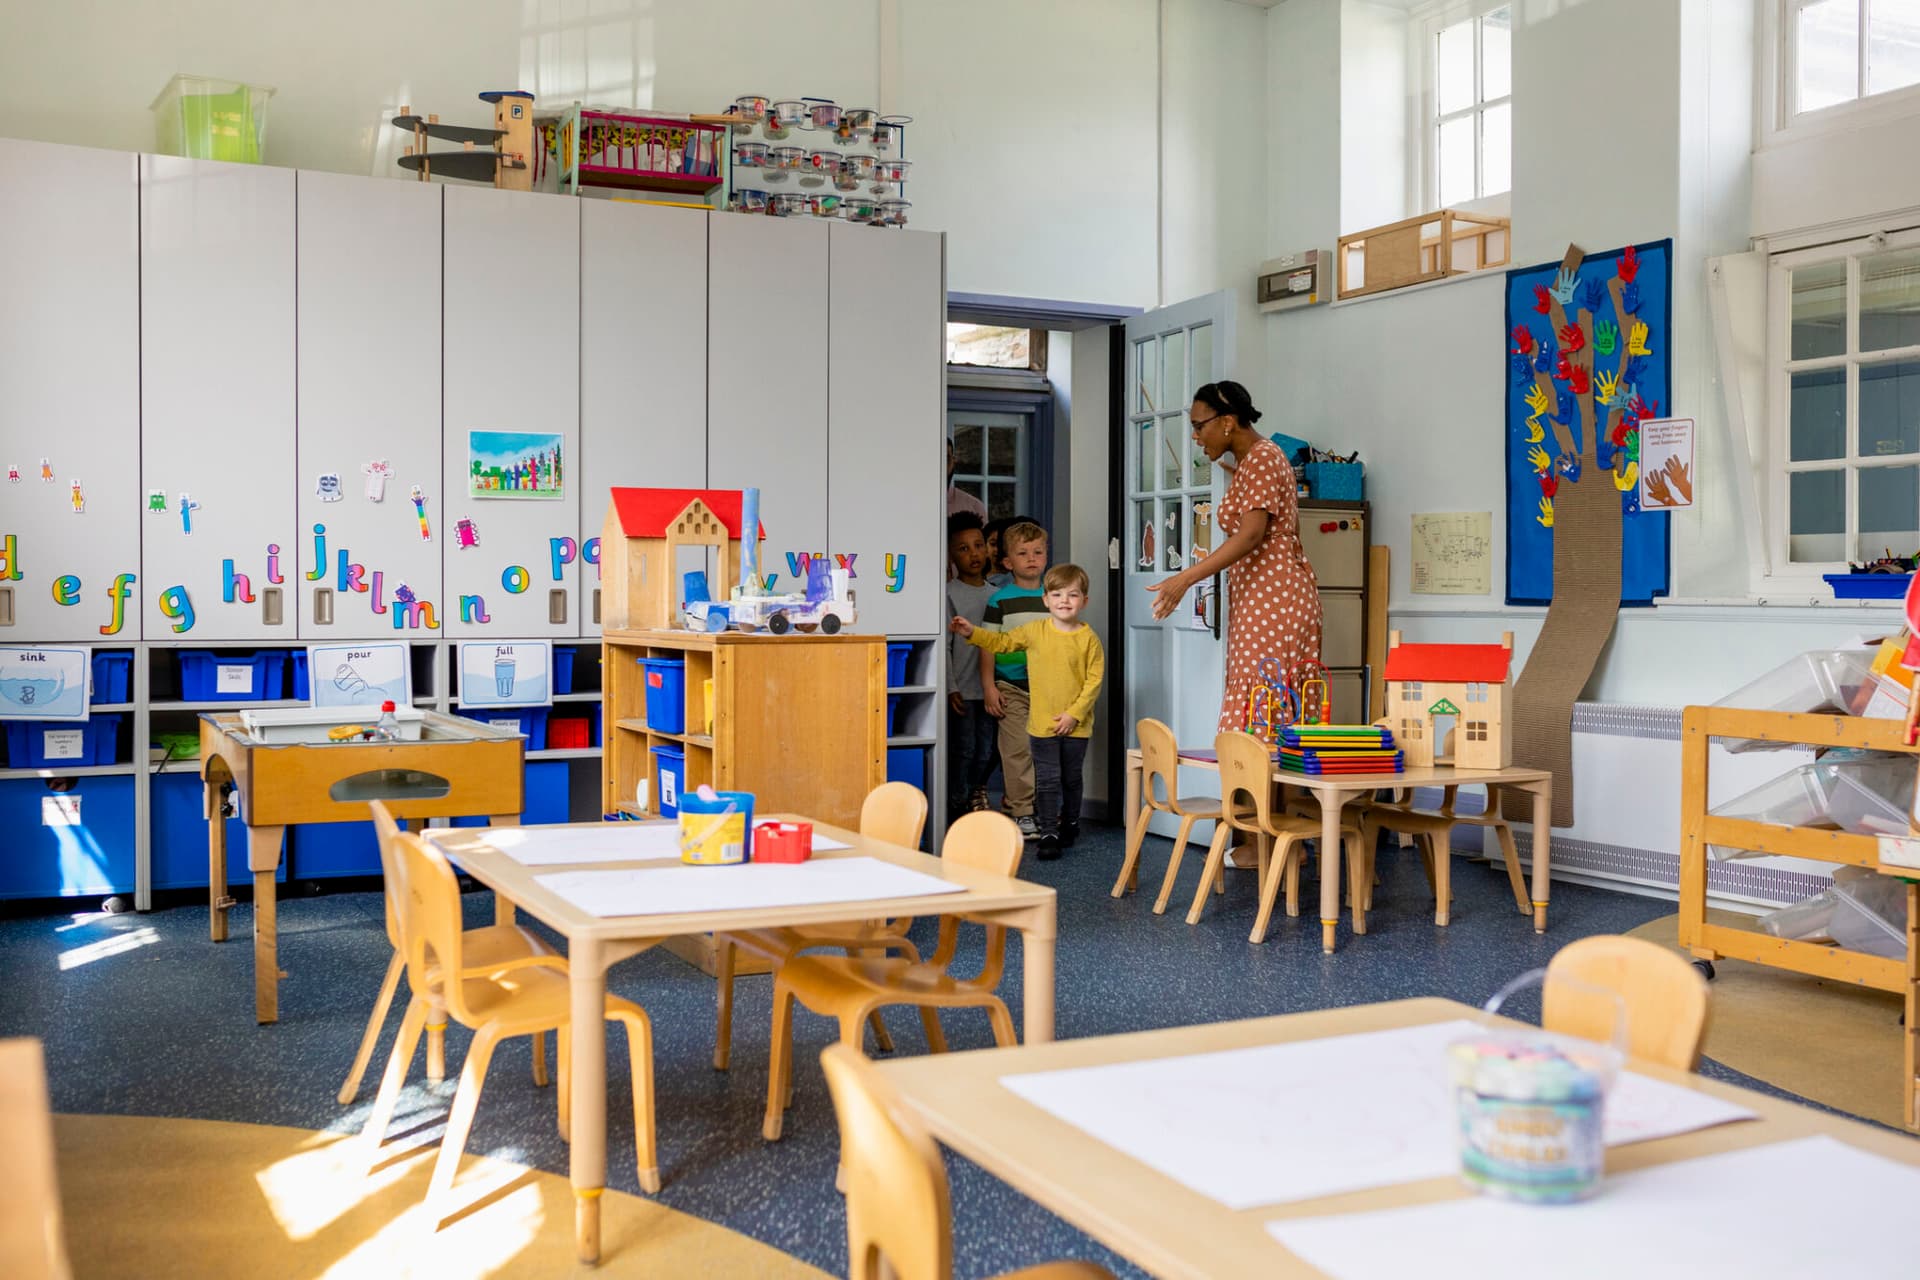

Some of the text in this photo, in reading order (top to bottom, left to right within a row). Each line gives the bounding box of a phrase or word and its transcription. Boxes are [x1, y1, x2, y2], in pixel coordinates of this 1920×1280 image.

[0, 534, 136, 635] d e f
[159, 543, 284, 633] g h i
[306, 523, 440, 629] j k l m
[460, 595, 491, 624] n
[501, 565, 530, 594] o
[550, 536, 577, 581] p
[834, 553, 858, 578] x
[885, 553, 906, 593] y
[20, 652, 46, 662] sink
[347, 651, 371, 662] pour
[495, 646, 513, 658] full
